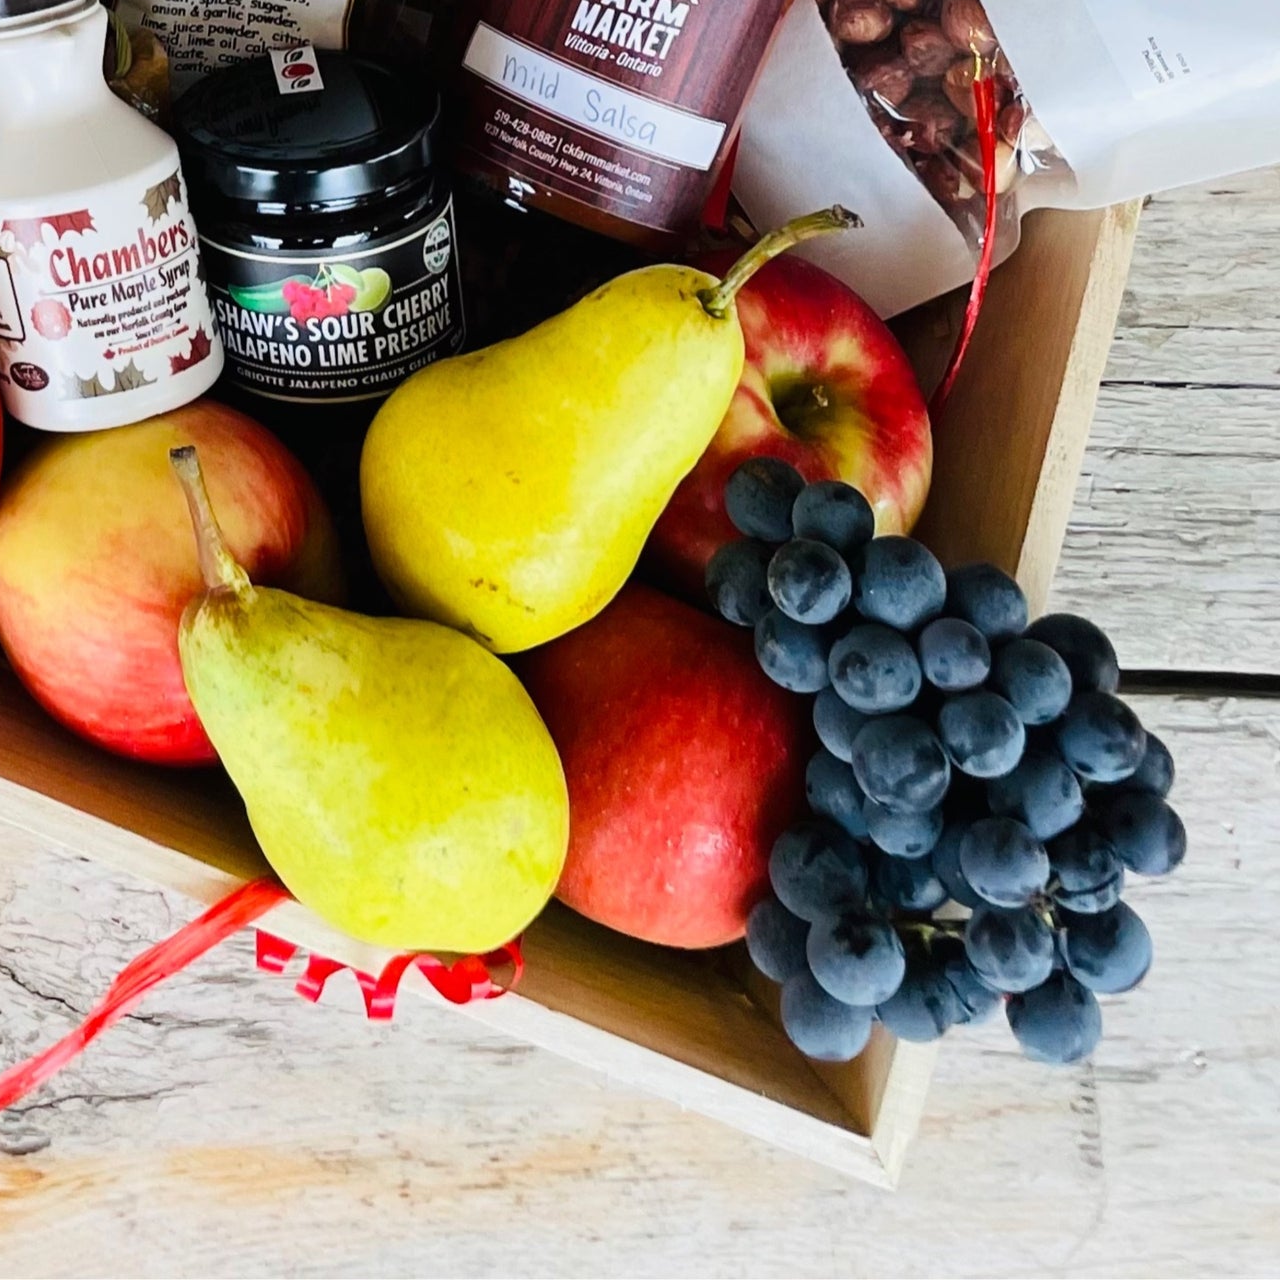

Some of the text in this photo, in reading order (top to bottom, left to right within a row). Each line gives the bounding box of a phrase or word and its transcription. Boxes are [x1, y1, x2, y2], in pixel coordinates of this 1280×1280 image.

[141, 13, 310, 46] lime juice powder, citric
[152, 4, 300, 31] onion & garlic powder,
[250, 0, 291, 16] sugar,
[571, 0, 680, 60] MARKET
[188, 34, 241, 52] lime oil,
[564, 33, 662, 77] Vittoria Ontario
[583, 89, 657, 145] Salsa
[484, 122, 653, 203] 1231 Norfolk County Ontario
[493, 109, 651, 186] 519-428-0882 ckfarmmarket.com
[49, 219, 188, 288] Chambers
[68, 259, 190, 312] Pure Maple Syrup
[216, 273, 449, 342] SHAW'S SOUR CHERRY
[77, 303, 151, 328] Naturally produced
[106, 328, 120, 337] our
[122, 316, 149, 332] Norfolk
[151, 310, 173, 324] County
[221, 326, 311, 367] JALAPENO
[318, 340, 369, 367] LIME
[375, 302, 451, 360] PRESERVE
[237, 366, 405, 389] GRIOTTE JALAPENO CHAUX
